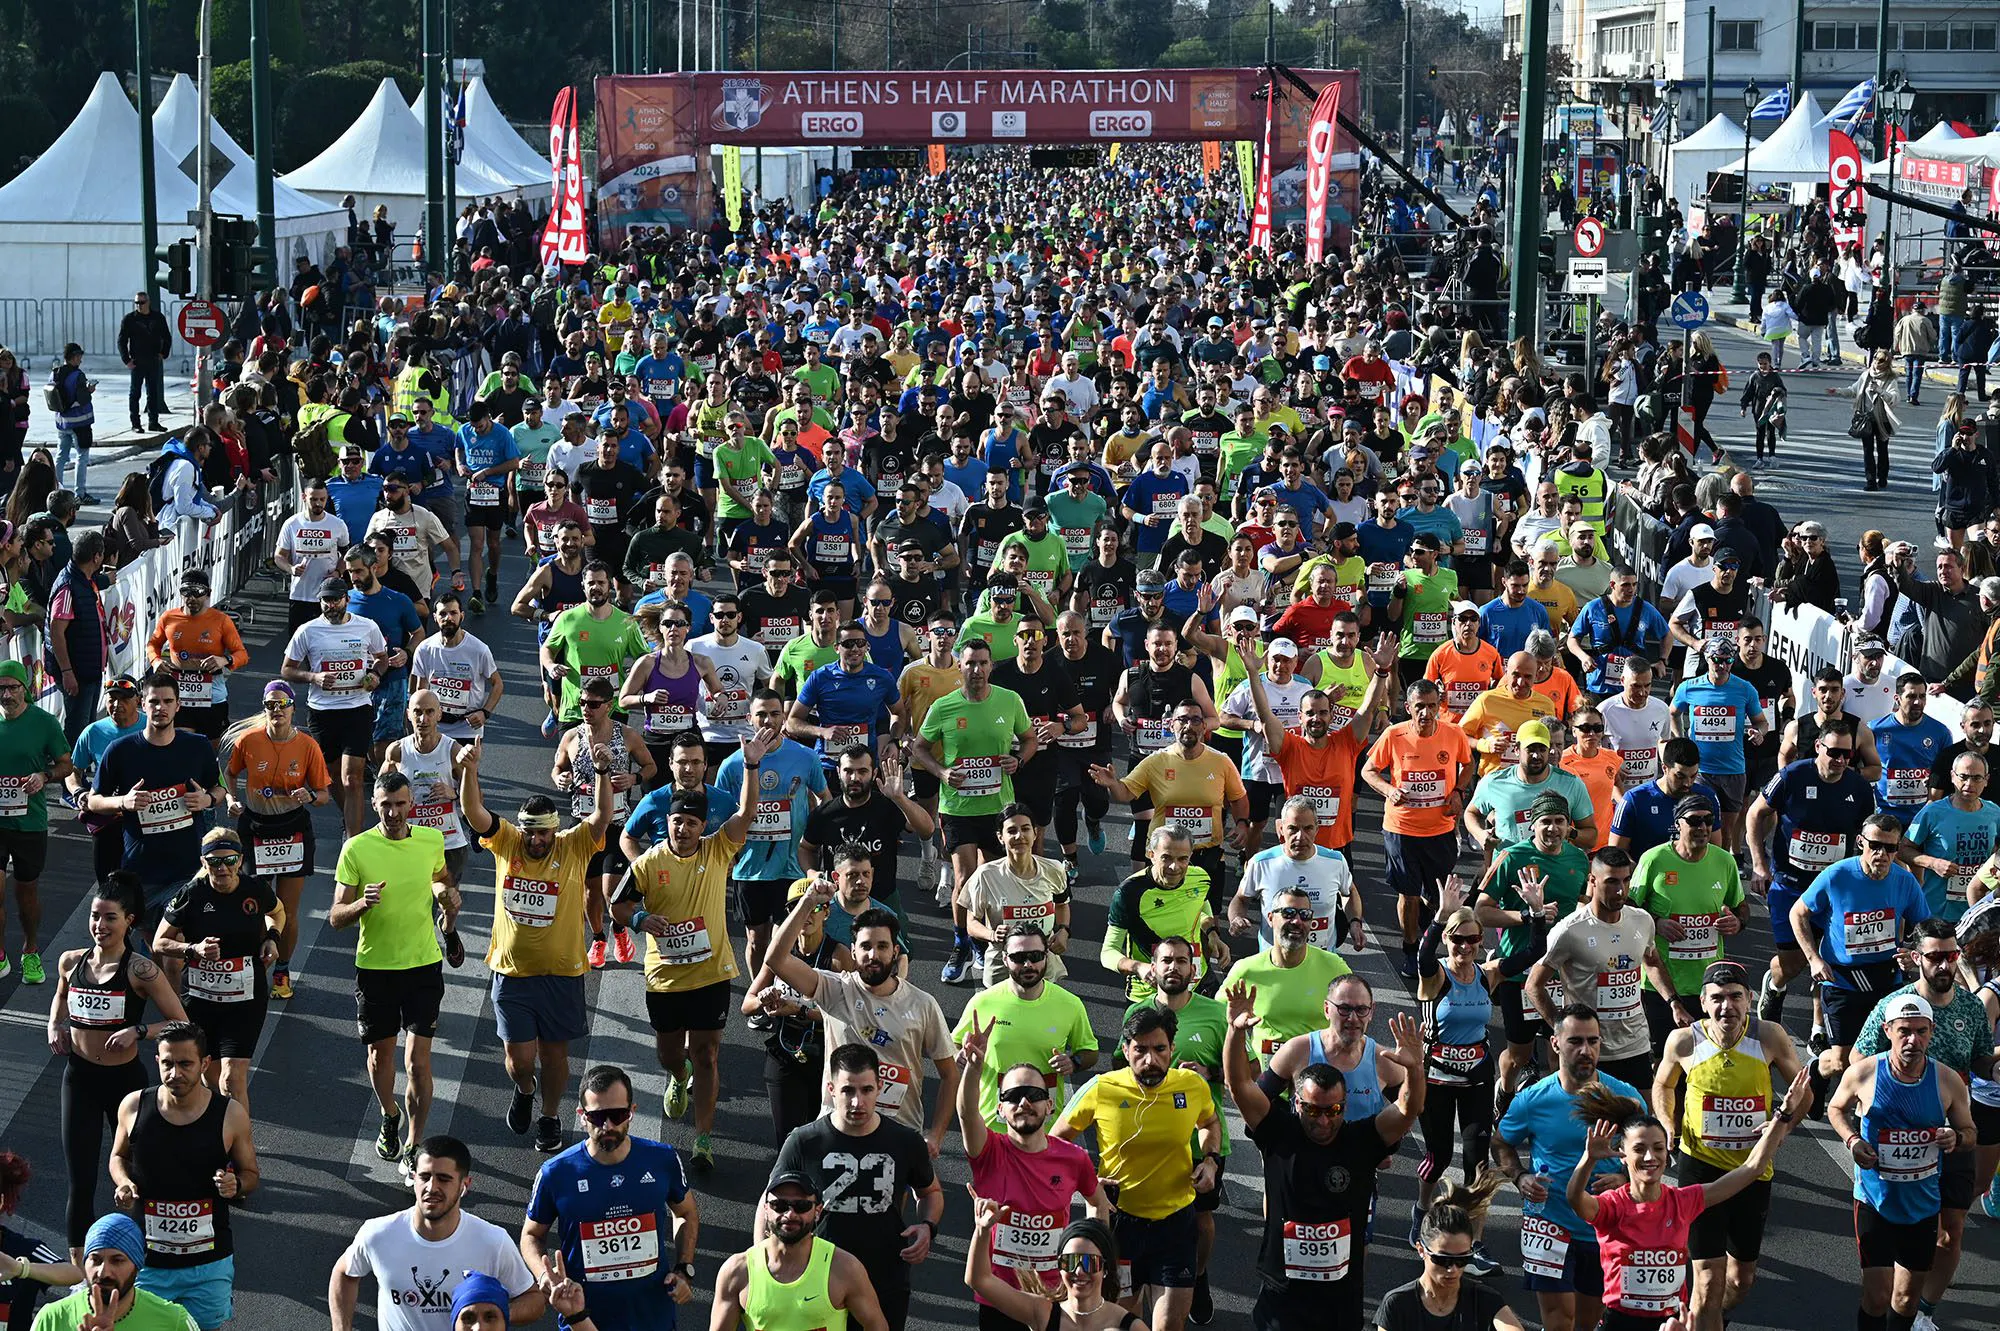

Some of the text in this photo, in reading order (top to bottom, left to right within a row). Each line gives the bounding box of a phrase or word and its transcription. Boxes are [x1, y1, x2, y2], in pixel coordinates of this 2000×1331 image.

[723, 79, 760, 88] SEGAS
[783, 79, 1174, 104] ATHENS HALF MARATHON
[807, 117, 858, 132] ERGO
[1095, 116, 1146, 131] ERGO
[635, 143, 655, 151] ERGO
[633, 163, 660, 176] 2024
[883, 480, 900, 488] 3697
[1571, 485, 1588, 497] 56
[590, 498, 610, 506] ERGO
[1158, 501, 1176, 509] 6805
[592, 506, 610, 514] 3020
[302, 530, 324, 538] ERGO
[823, 535, 844, 543] ERGO
[302, 539, 324, 547] 4416
[823, 542, 842, 551] 3581
[1026, 571, 1049, 580] ERGO
[1096, 599, 1118, 607] ERGO
[1098, 608, 1118, 616] 4877
[1420, 613, 1442, 621] ERGO
[767, 617, 793, 626] ERGO
[1421, 622, 1441, 630] 3235
[1711, 622, 1734, 630] ERGO
[768, 627, 791, 636] 4003
[328, 661, 355, 671] ERGO
[587, 667, 612, 675] ERGO
[178, 673, 203, 683] ERGO
[336, 672, 355, 681] 465
[179, 683, 203, 693] 5509
[436, 678, 463, 689] ERGO
[1455, 683, 1480, 691] ERGO
[436, 688, 460, 699] 4332
[658, 705, 685, 713] ERGO
[1700, 707, 1727, 716] ERGO
[659, 714, 683, 724] 3691
[1701, 718, 1726, 727] 4494
[1624, 751, 1651, 760] ERGO
[963, 758, 992, 767] ERGO
[1625, 761, 1650, 770] 3407
[1408, 772, 1436, 781] ERGO
[1894, 769, 1921, 778] ERGO
[1410, 783, 1436, 793] 4605
[1896, 780, 1921, 789] 3547
[1302, 787, 1332, 797] ERGO
[148, 800, 179, 815] 4646
[416, 806, 443, 817] ERGO
[1173, 808, 1204, 817] ERGO
[418, 817, 443, 827] 4490
[1800, 831, 1830, 843] ERGO
[1956, 832, 1989, 840] IF YOU
[265, 845, 292, 856] 3267
[1799, 844, 1828, 855] 4719
[1956, 839, 1989, 851] RUN
[512, 878, 548, 893] ERGO
[512, 893, 544, 907] 4108
[1013, 905, 1047, 918] ERGO
[1678, 916, 1710, 927] ERGO
[1853, 911, 1885, 924] ERGO
[663, 921, 695, 935] ERGO
[1855, 922, 1884, 936] 4470
[666, 935, 696, 950] 4057
[198, 959, 233, 972] ERGO
[200, 972, 232, 984] 3375
[1608, 972, 1638, 986] ERGO
[1609, 985, 1636, 1000] 3386
[77, 995, 110, 1011] 3925
[1441, 1046, 1476, 1060] ERGO
[1713, 1098, 1755, 1111] ERGO
[1716, 1114, 1753, 1128] 1706
[1889, 1131, 1931, 1144] ERGO
[1892, 1145, 1928, 1160] 4427
[822, 1152, 895, 1214] 23
[156, 1203, 200, 1217] ERGO
[1010, 1211, 1054, 1229] ERGO
[158, 1219, 197, 1234] 4246
[593, 1217, 641, 1237] ERGO
[1295, 1223, 1339, 1240] ERGO
[1523, 1216, 1559, 1236] ERGO
[1010, 1230, 1050, 1246] 3592
[1523, 1233, 1553, 1251] 3770
[598, 1236, 642, 1255] 3612
[1299, 1241, 1338, 1256] 5951
[1633, 1250, 1678, 1265] ERGO
[1636, 1268, 1675, 1284] 3768
